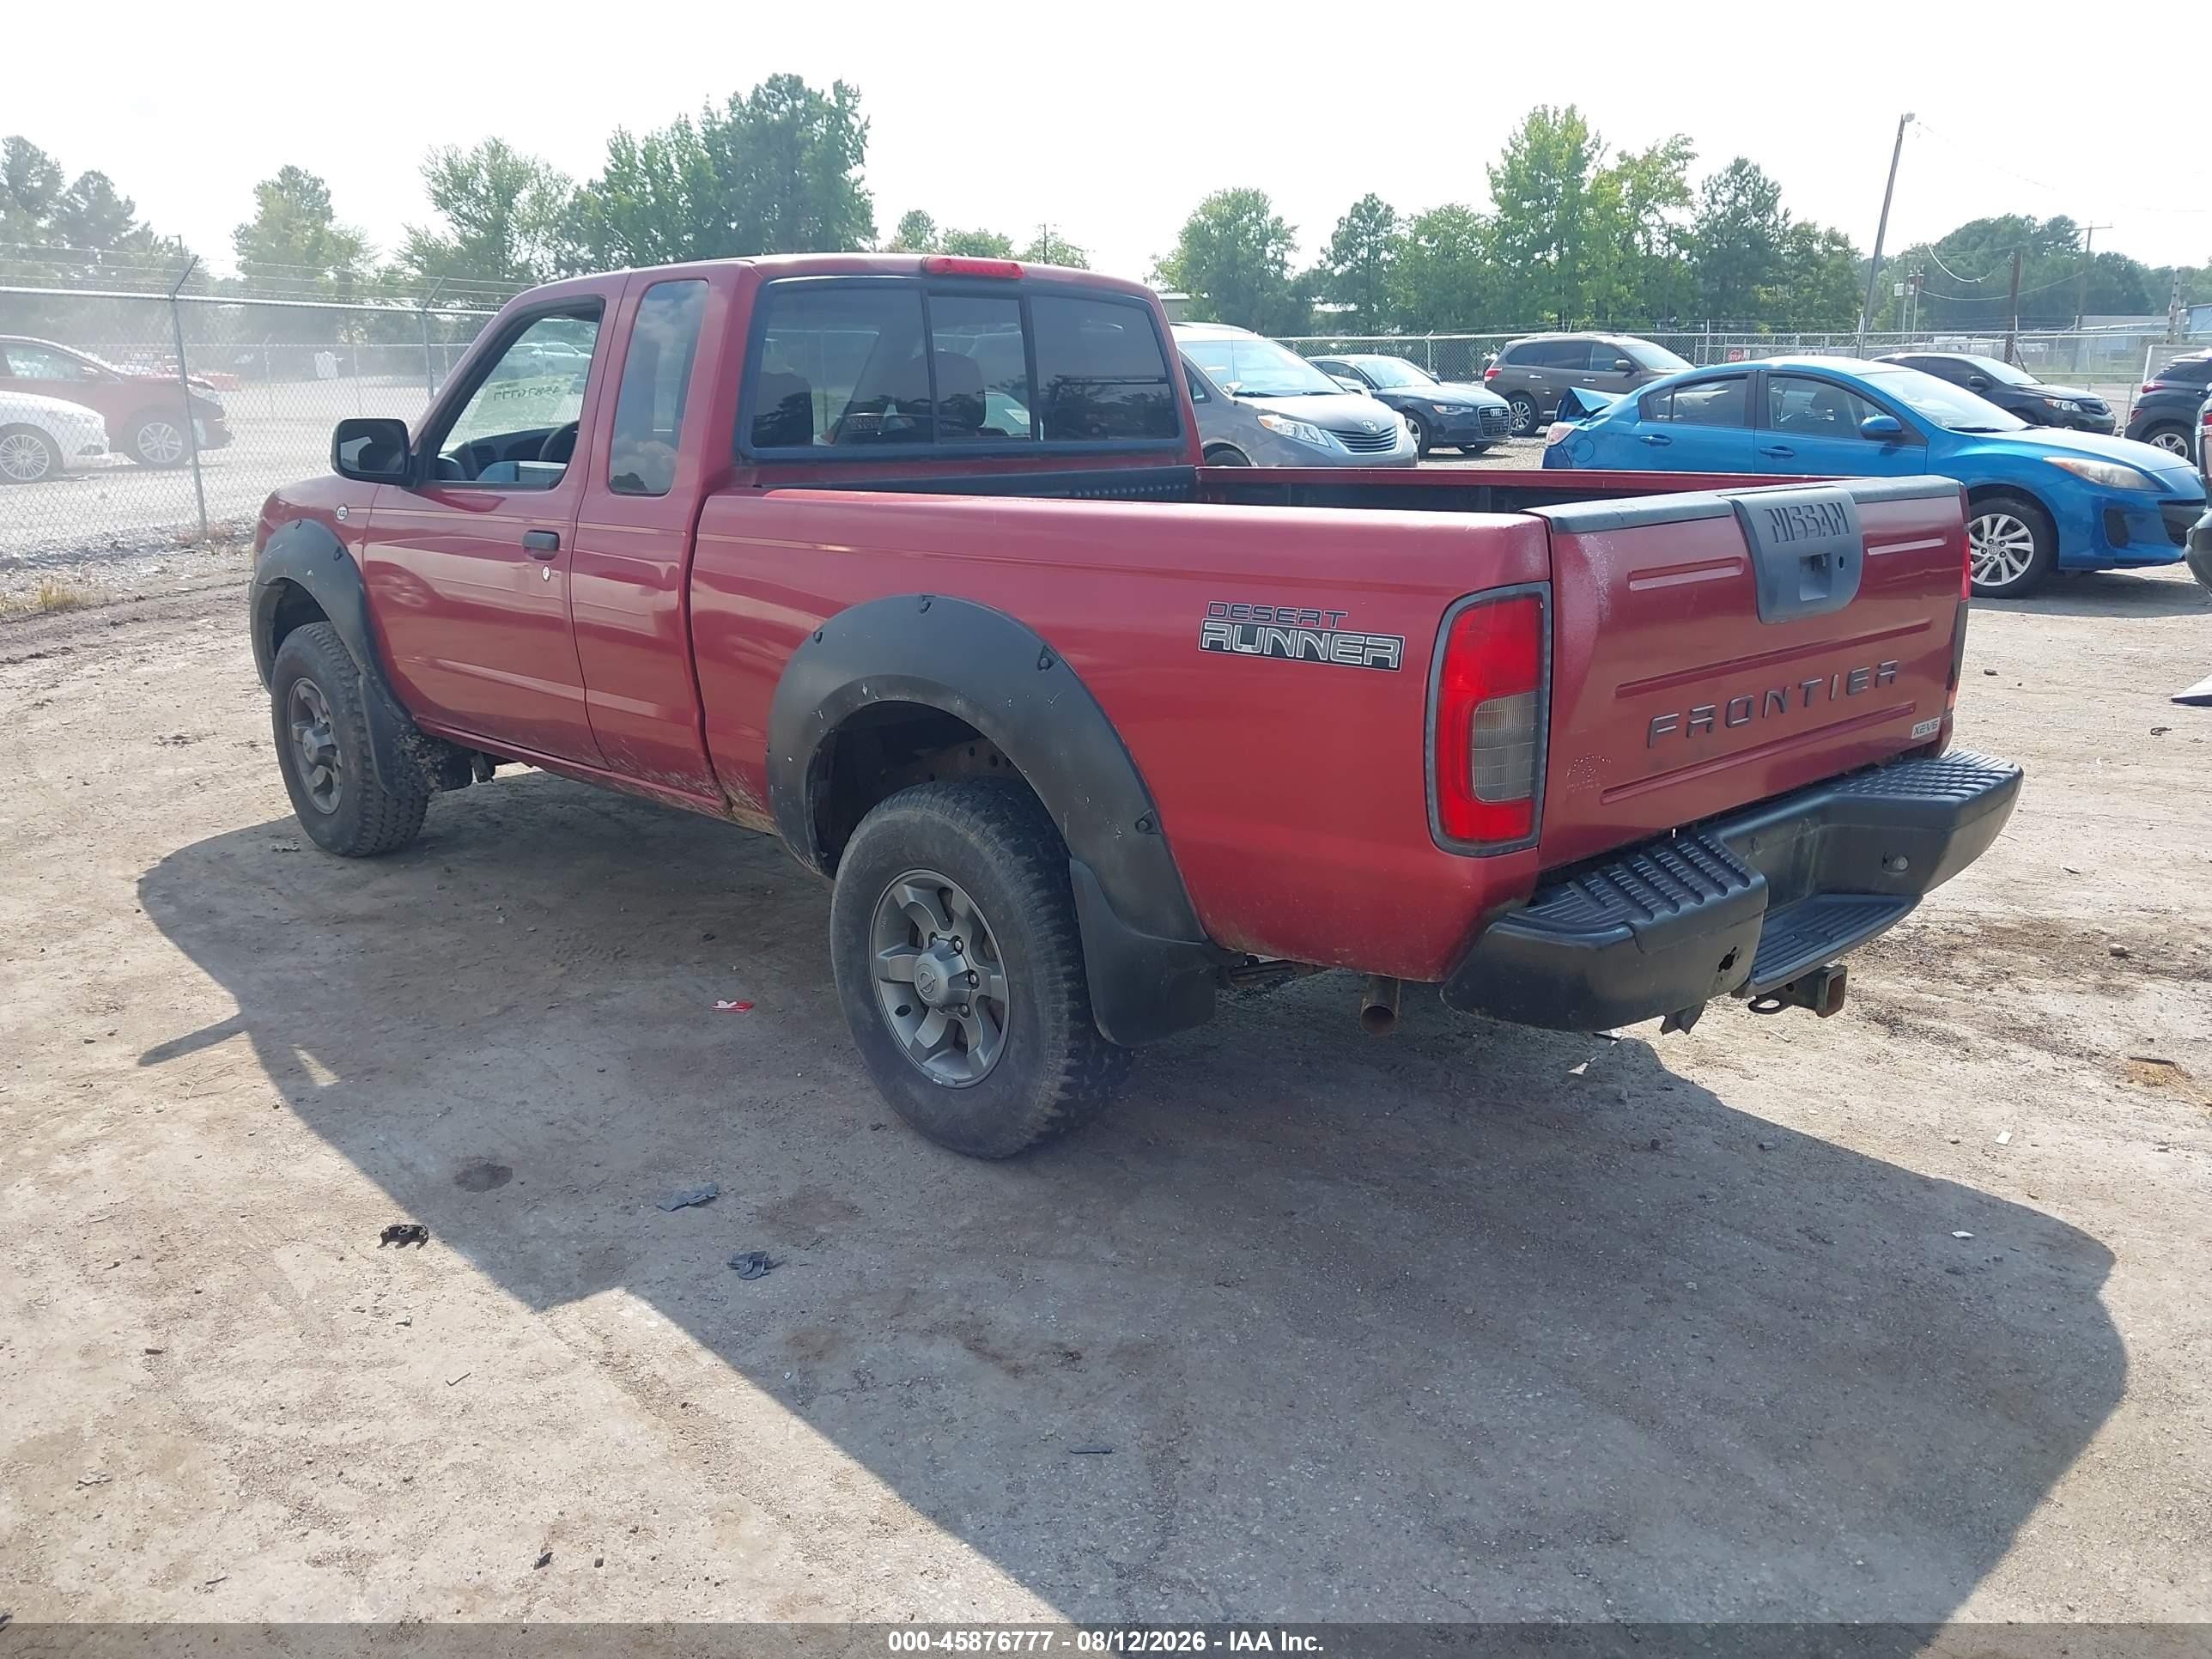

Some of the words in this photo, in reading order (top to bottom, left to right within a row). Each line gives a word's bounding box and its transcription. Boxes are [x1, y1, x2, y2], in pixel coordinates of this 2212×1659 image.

[1764, 502, 1850, 544] NISSAN
[1206, 601, 1348, 629] DESERT
[1200, 620, 1403, 669] RUNNER
[1647, 659, 1901, 750] FRONTIER
